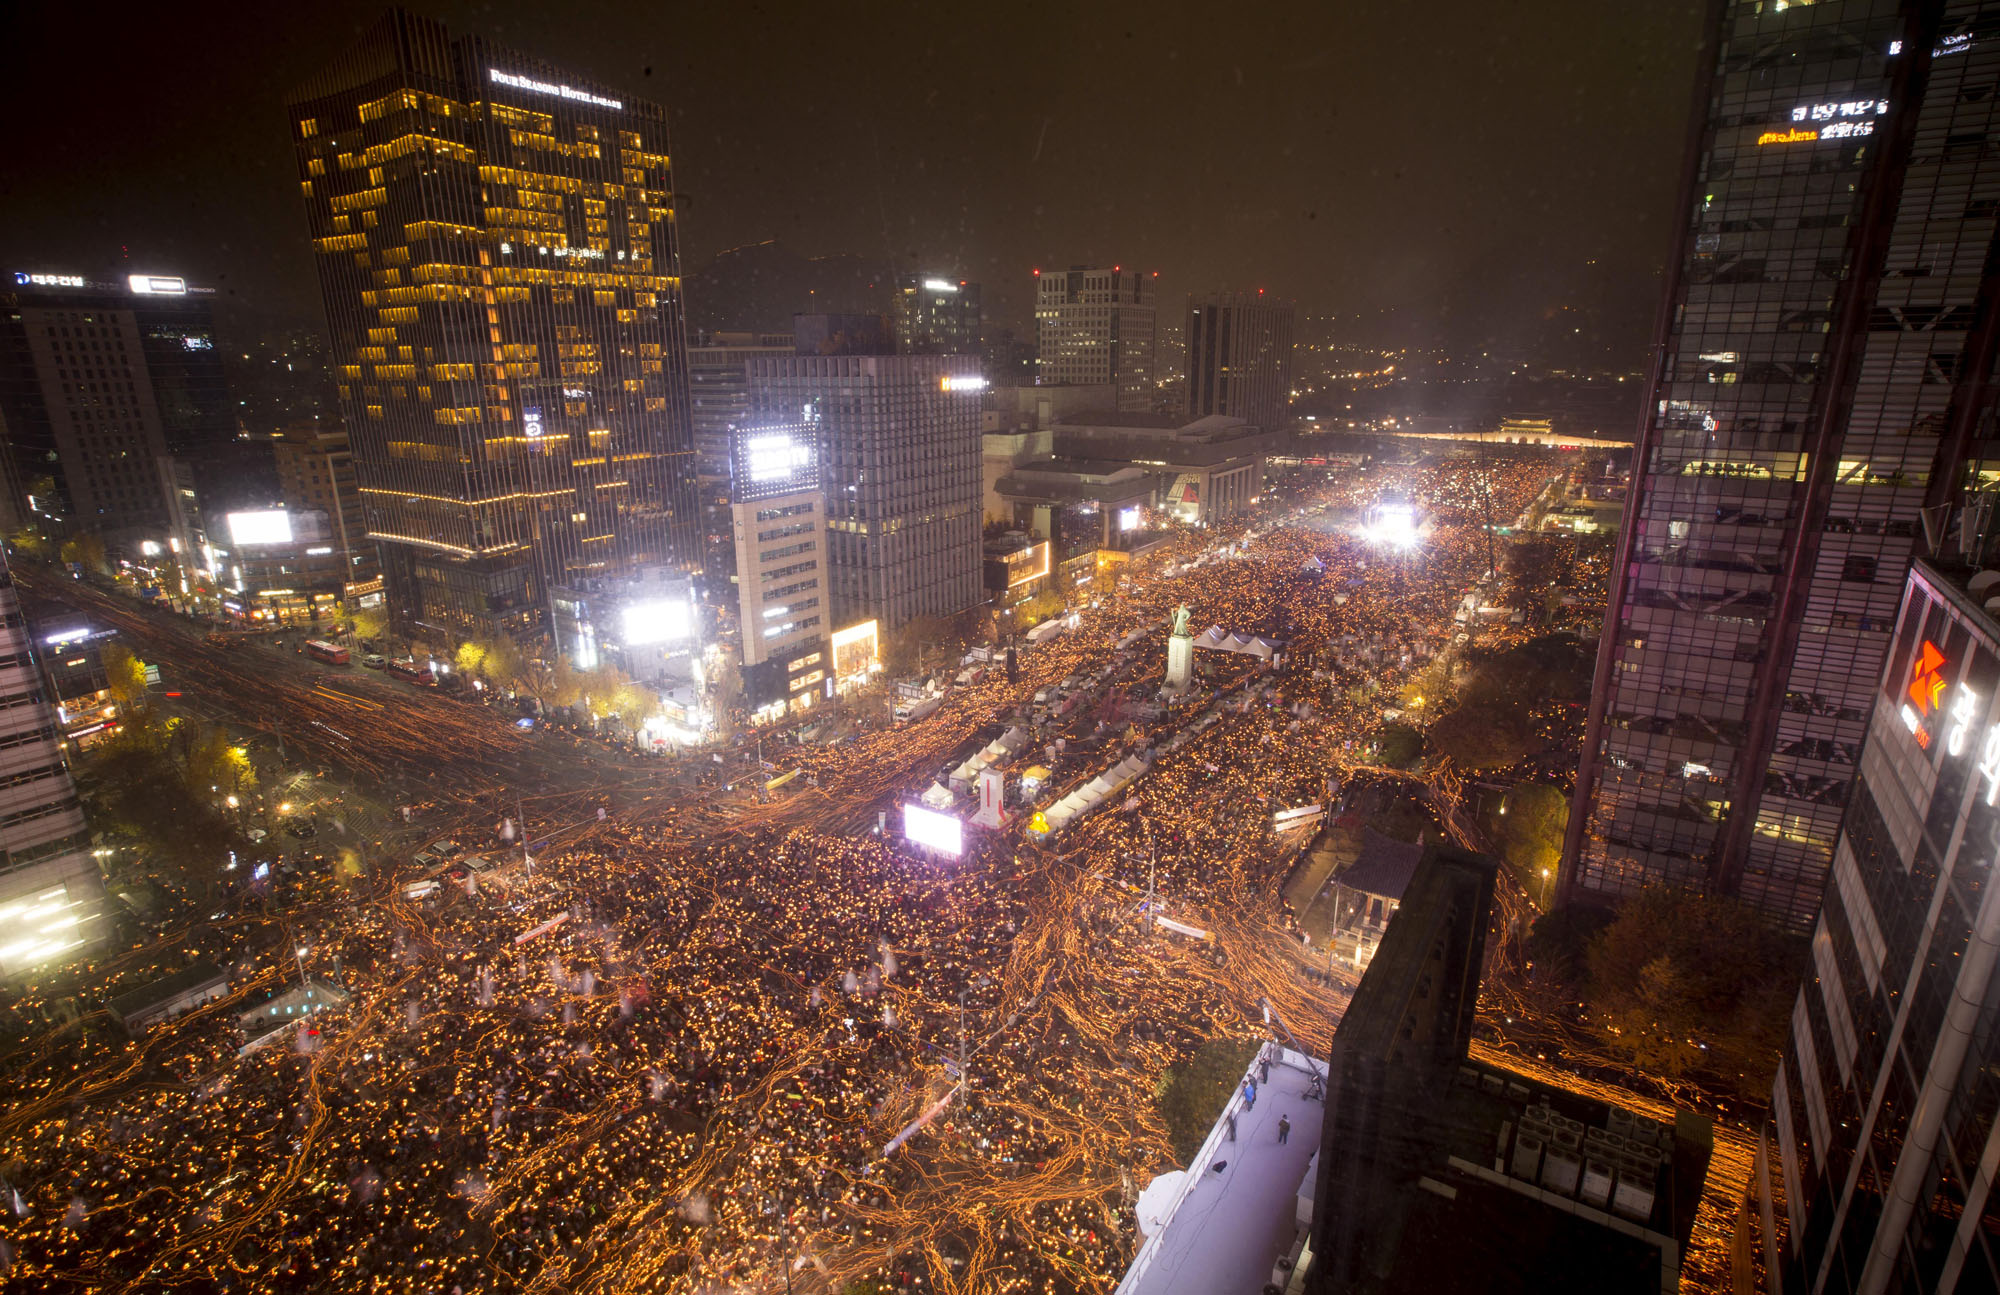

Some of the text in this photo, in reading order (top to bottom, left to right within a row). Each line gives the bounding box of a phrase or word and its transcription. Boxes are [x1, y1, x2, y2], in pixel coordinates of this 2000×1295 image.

[490, 69, 519, 87] FOUR
[519, 75, 559, 96] SEASONS
[560, 85, 592, 103] HOTEL
[31, 274, 84, 287] 대우건설
[1915, 724, 1930, 749] POST
